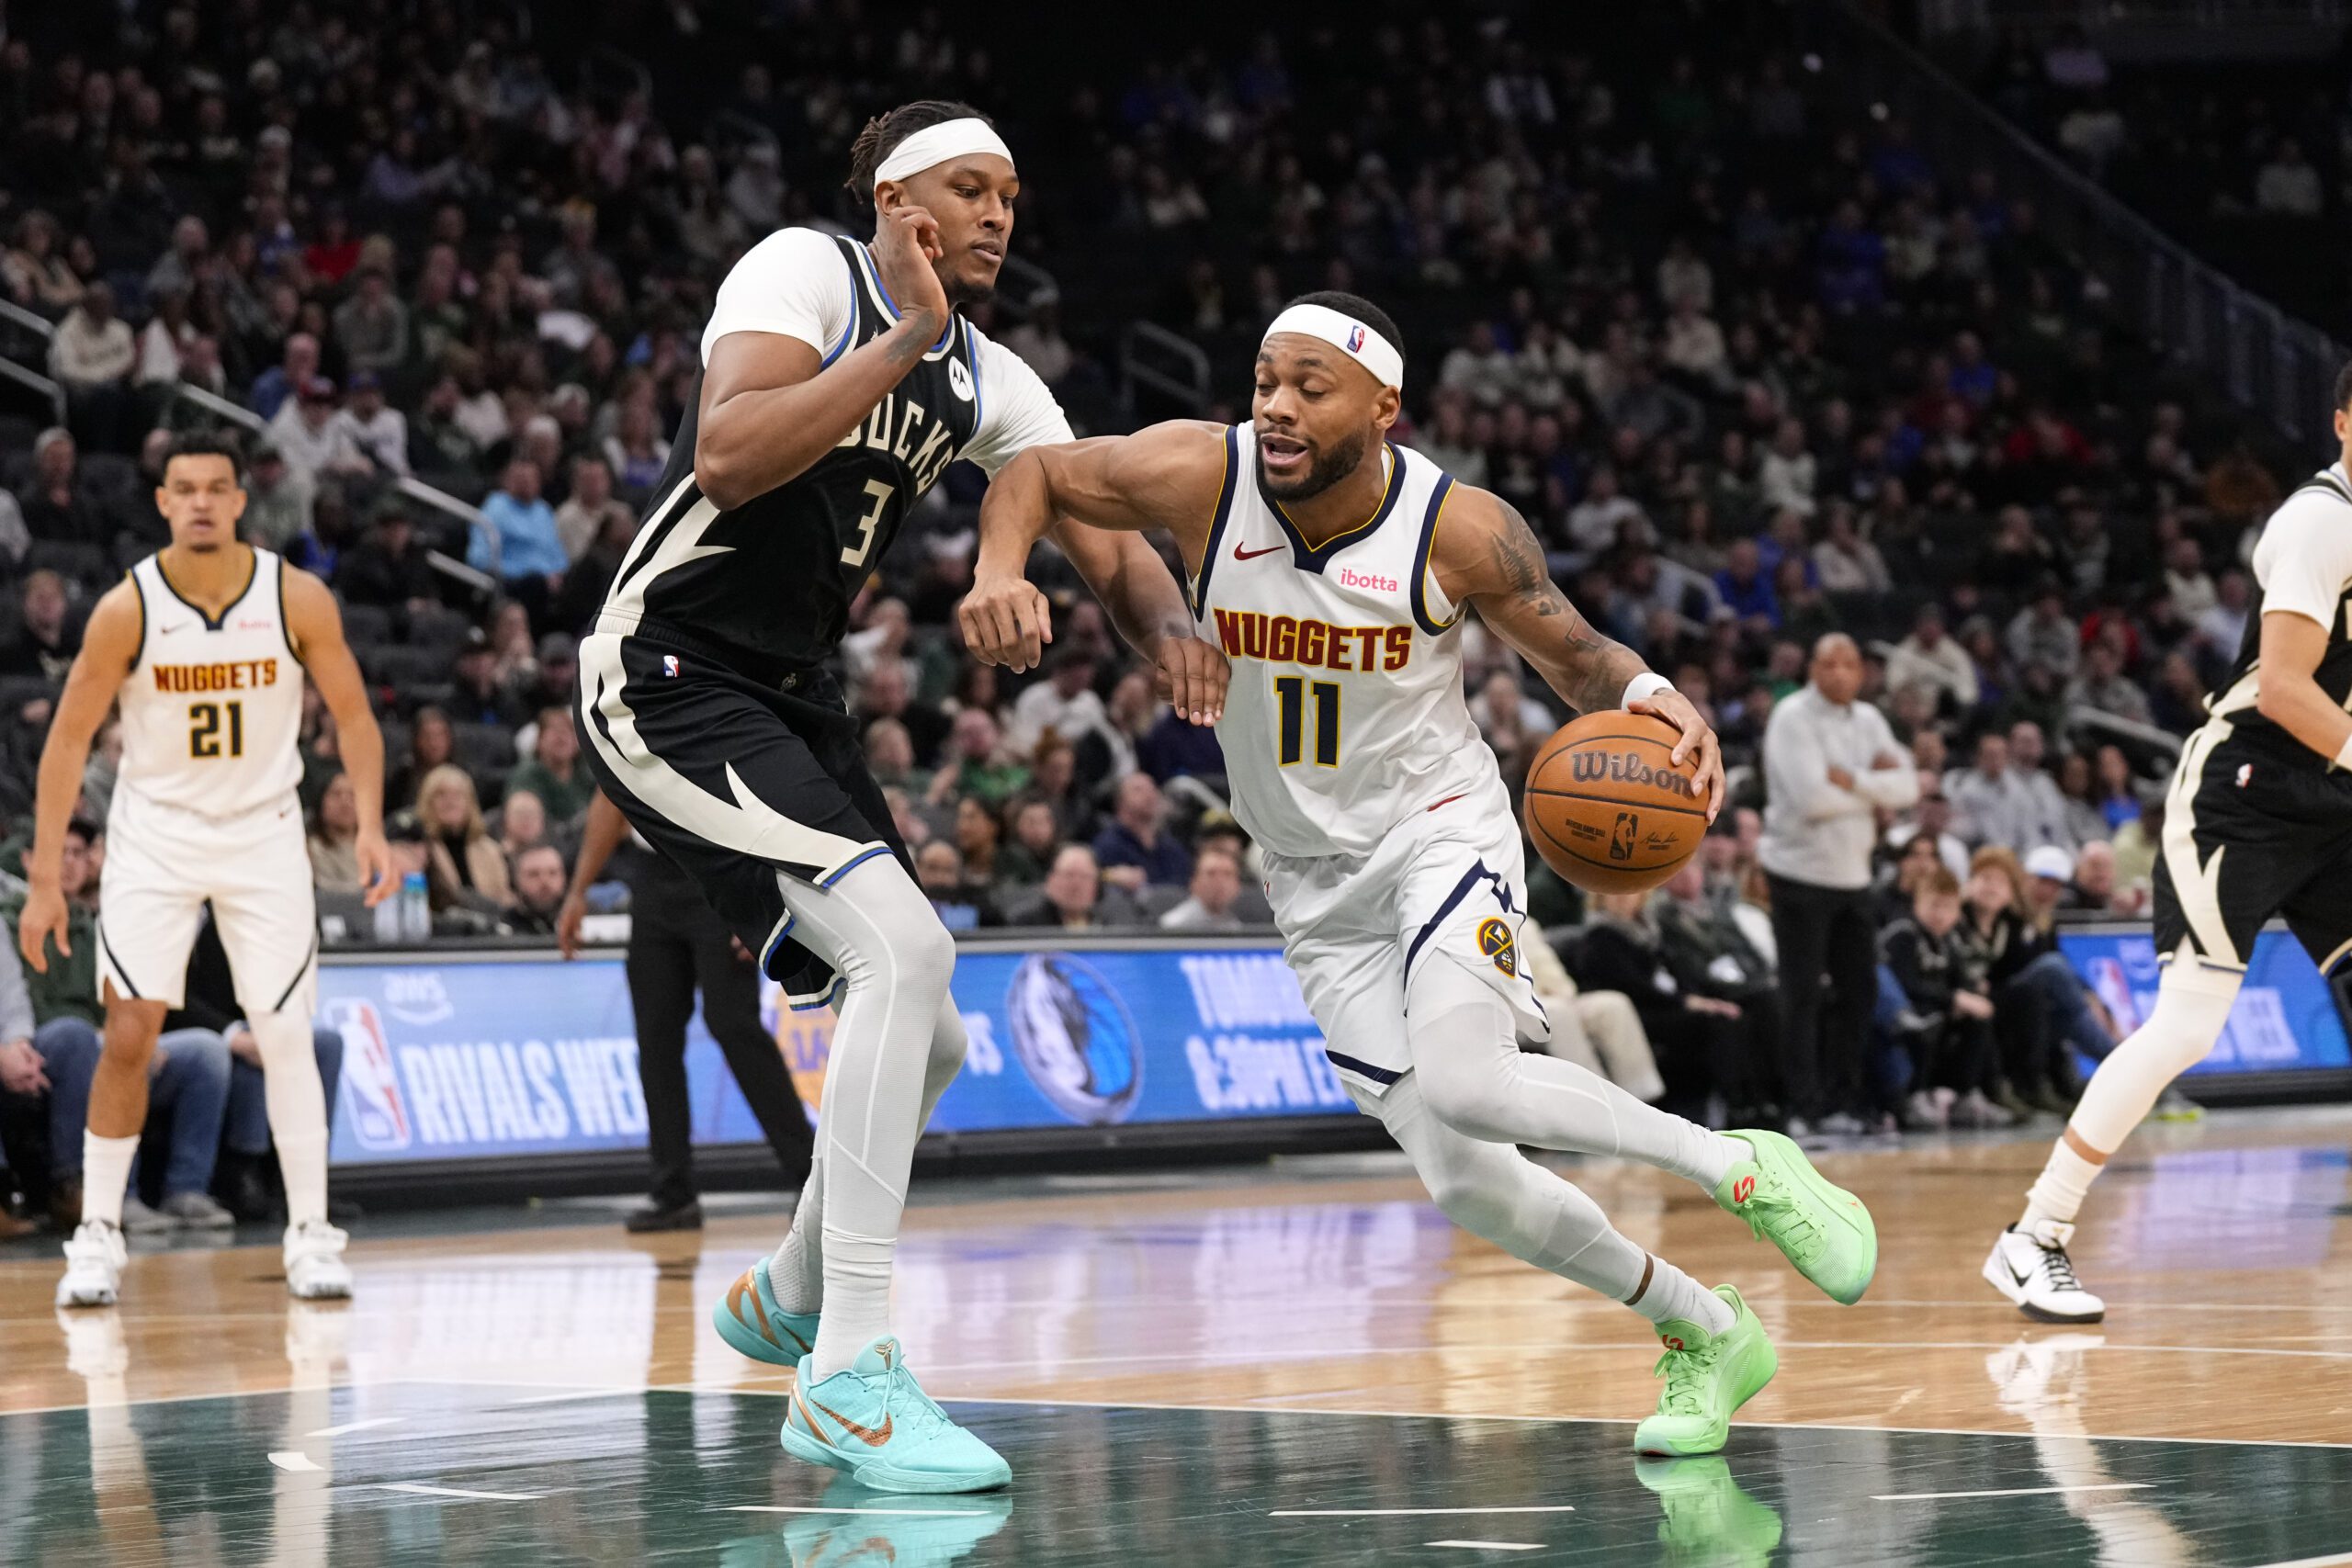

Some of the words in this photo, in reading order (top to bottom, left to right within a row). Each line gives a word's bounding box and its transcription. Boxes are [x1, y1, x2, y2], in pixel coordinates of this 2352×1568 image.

[840, 479, 895, 567] 3
[1340, 569, 1397, 592] ibotta
[1213, 607, 1413, 672] NUGGETS
[152, 656, 277, 694] NUGGETS
[188, 699, 244, 759] 21
[1274, 675, 1340, 768] 11
[1571, 750, 1697, 800] Wilson
[400, 1040, 571, 1145] RIVALS
